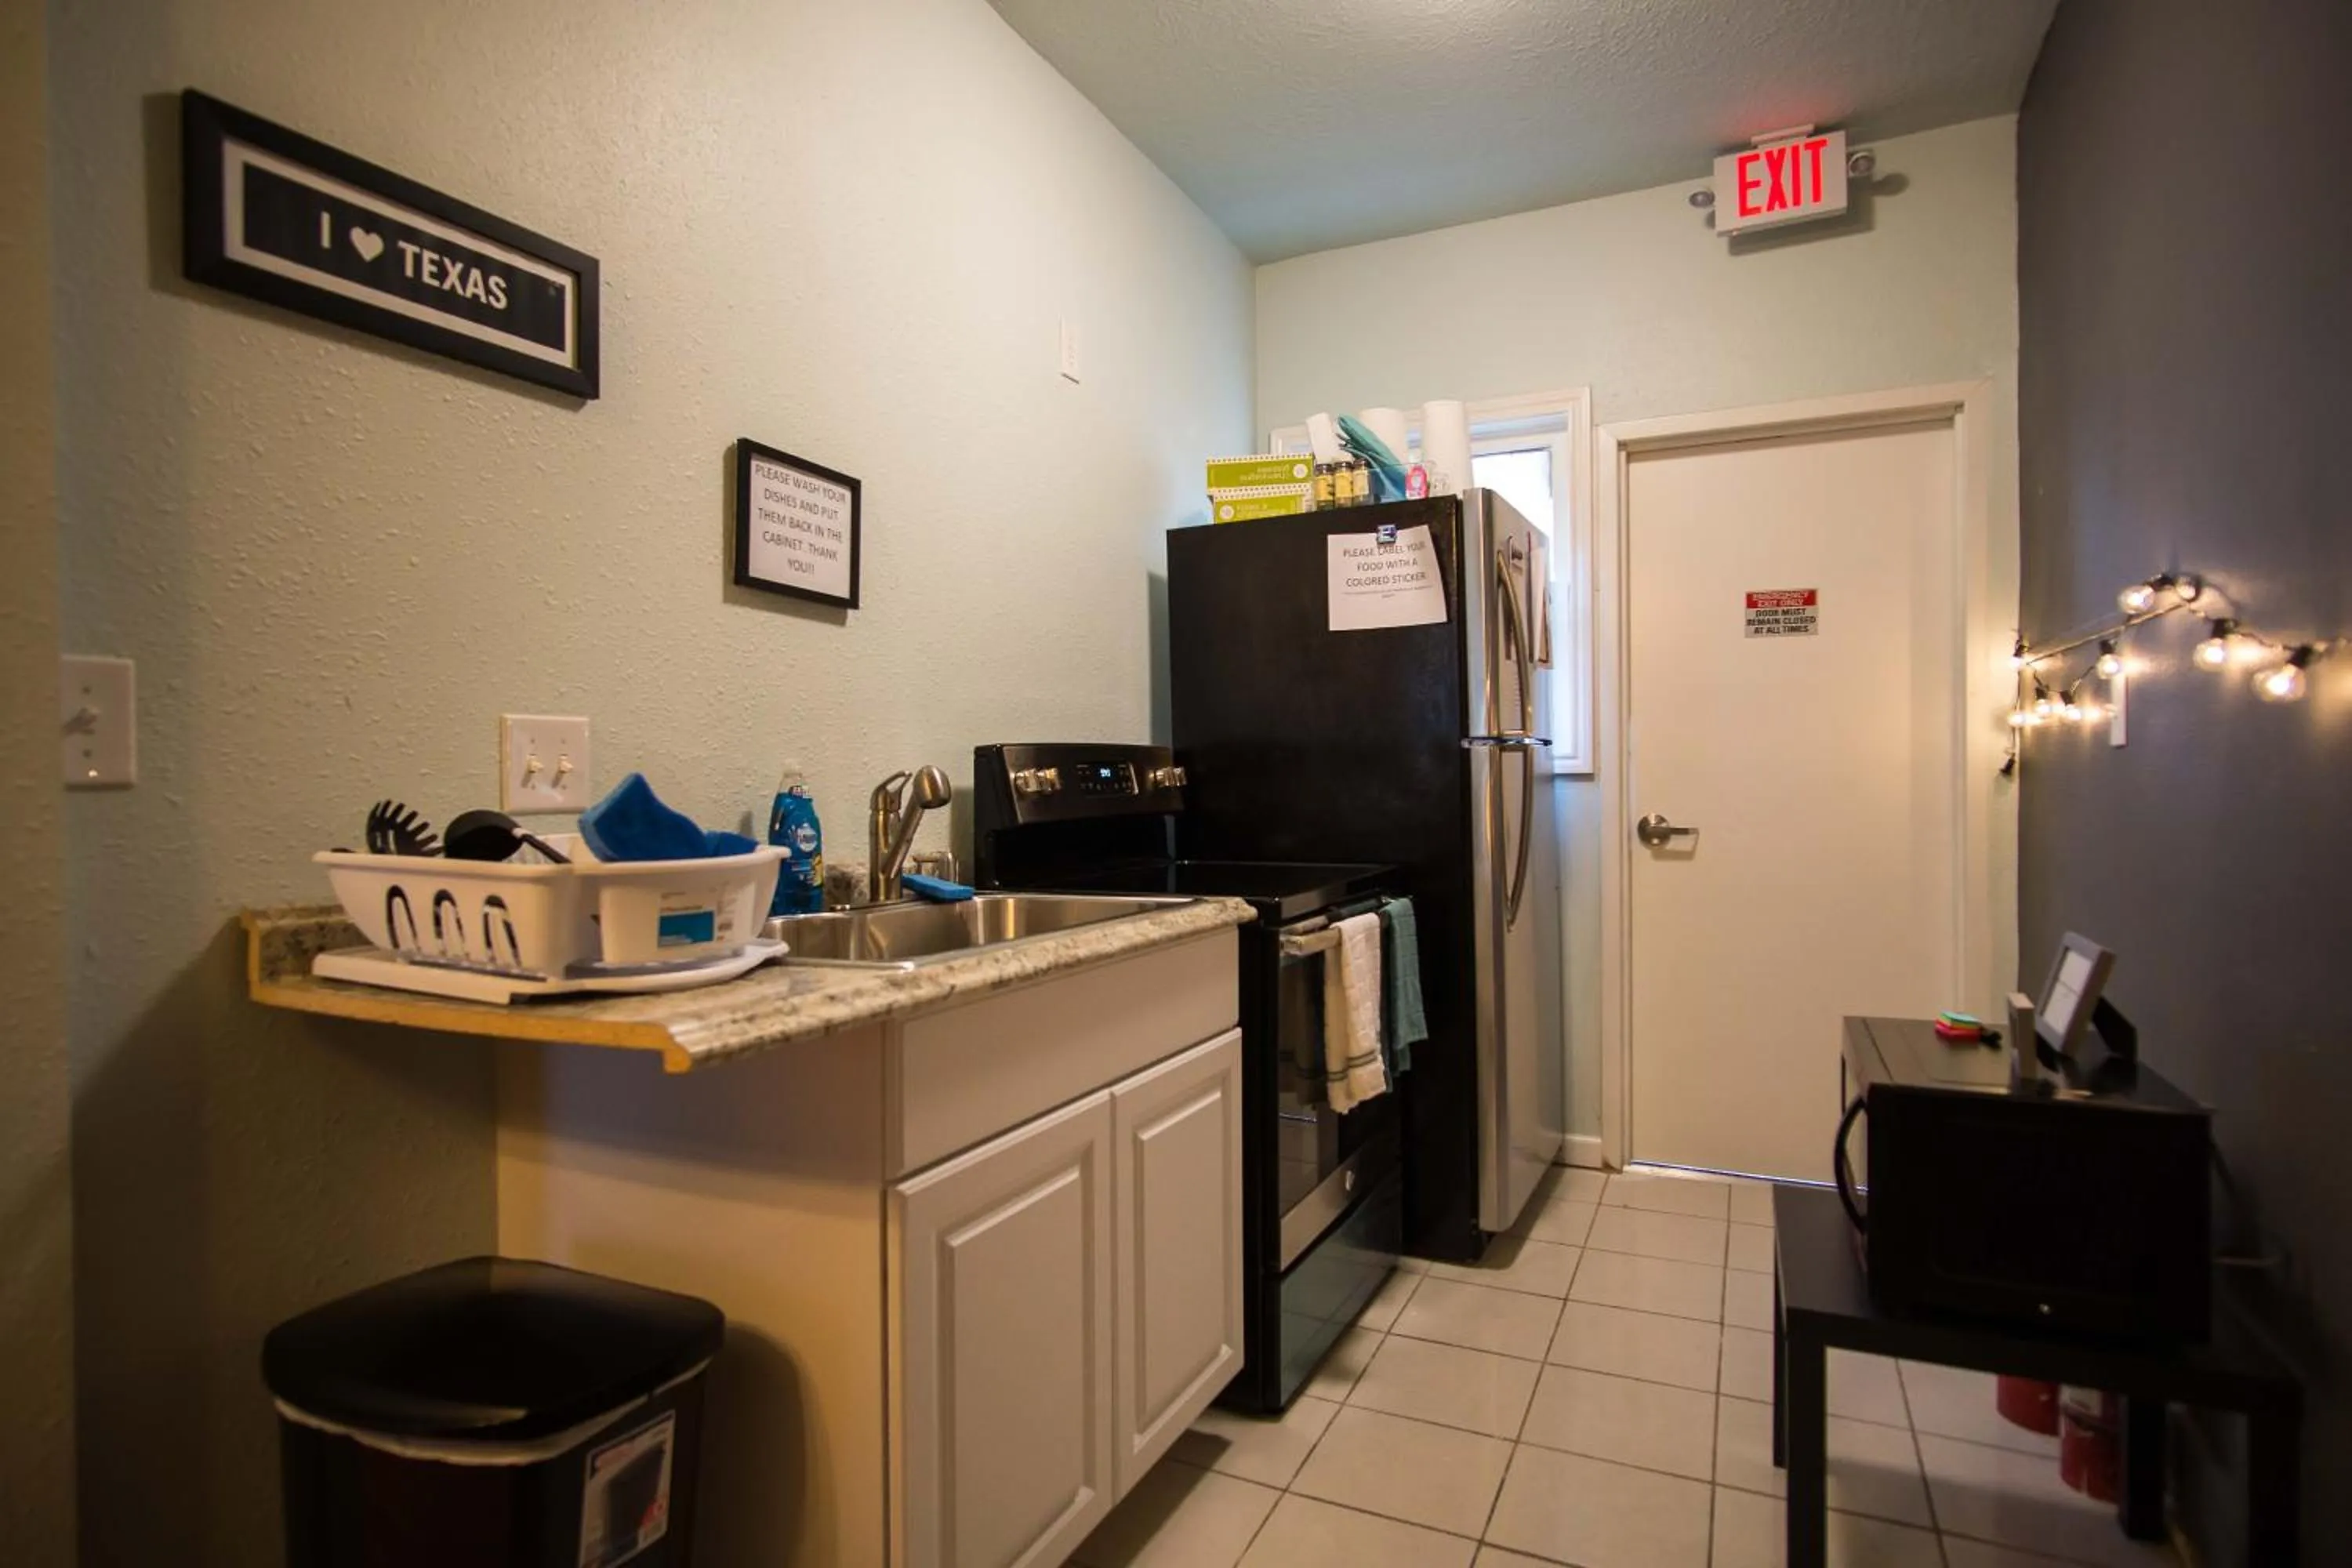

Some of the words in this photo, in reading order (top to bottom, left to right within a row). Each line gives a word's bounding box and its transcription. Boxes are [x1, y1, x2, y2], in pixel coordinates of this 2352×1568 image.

[1737, 138, 1829, 217] EXIT
[320, 211, 331, 249] I
[397, 241, 508, 310] TEXAS
[755, 464, 790, 485] PLEASE
[793, 477, 820, 494] WASH
[823, 488, 846, 503] YOUR
[764, 488, 797, 508] DISHES
[799, 500, 819, 515] AND
[821, 506, 839, 521] PUT
[758, 507, 786, 525] THEM
[789, 517, 813, 534] BACK
[815, 525, 824, 537] IN
[827, 528, 843, 543] THE
[808, 543, 838, 561] THANK
[1343, 548, 1376, 557] PLEASE
[1377, 546, 1403, 556] LABEL
[1406, 541, 1426, 551] YOUR
[1357, 562, 1384, 572] FOOD
[1385, 560, 1410, 570] WITH
[1412, 557, 1418, 566] A
[1346, 576, 1390, 587] COLORED
[1392, 572, 1426, 584] STICKER
[1782, 615, 1817, 624] CLOSED
